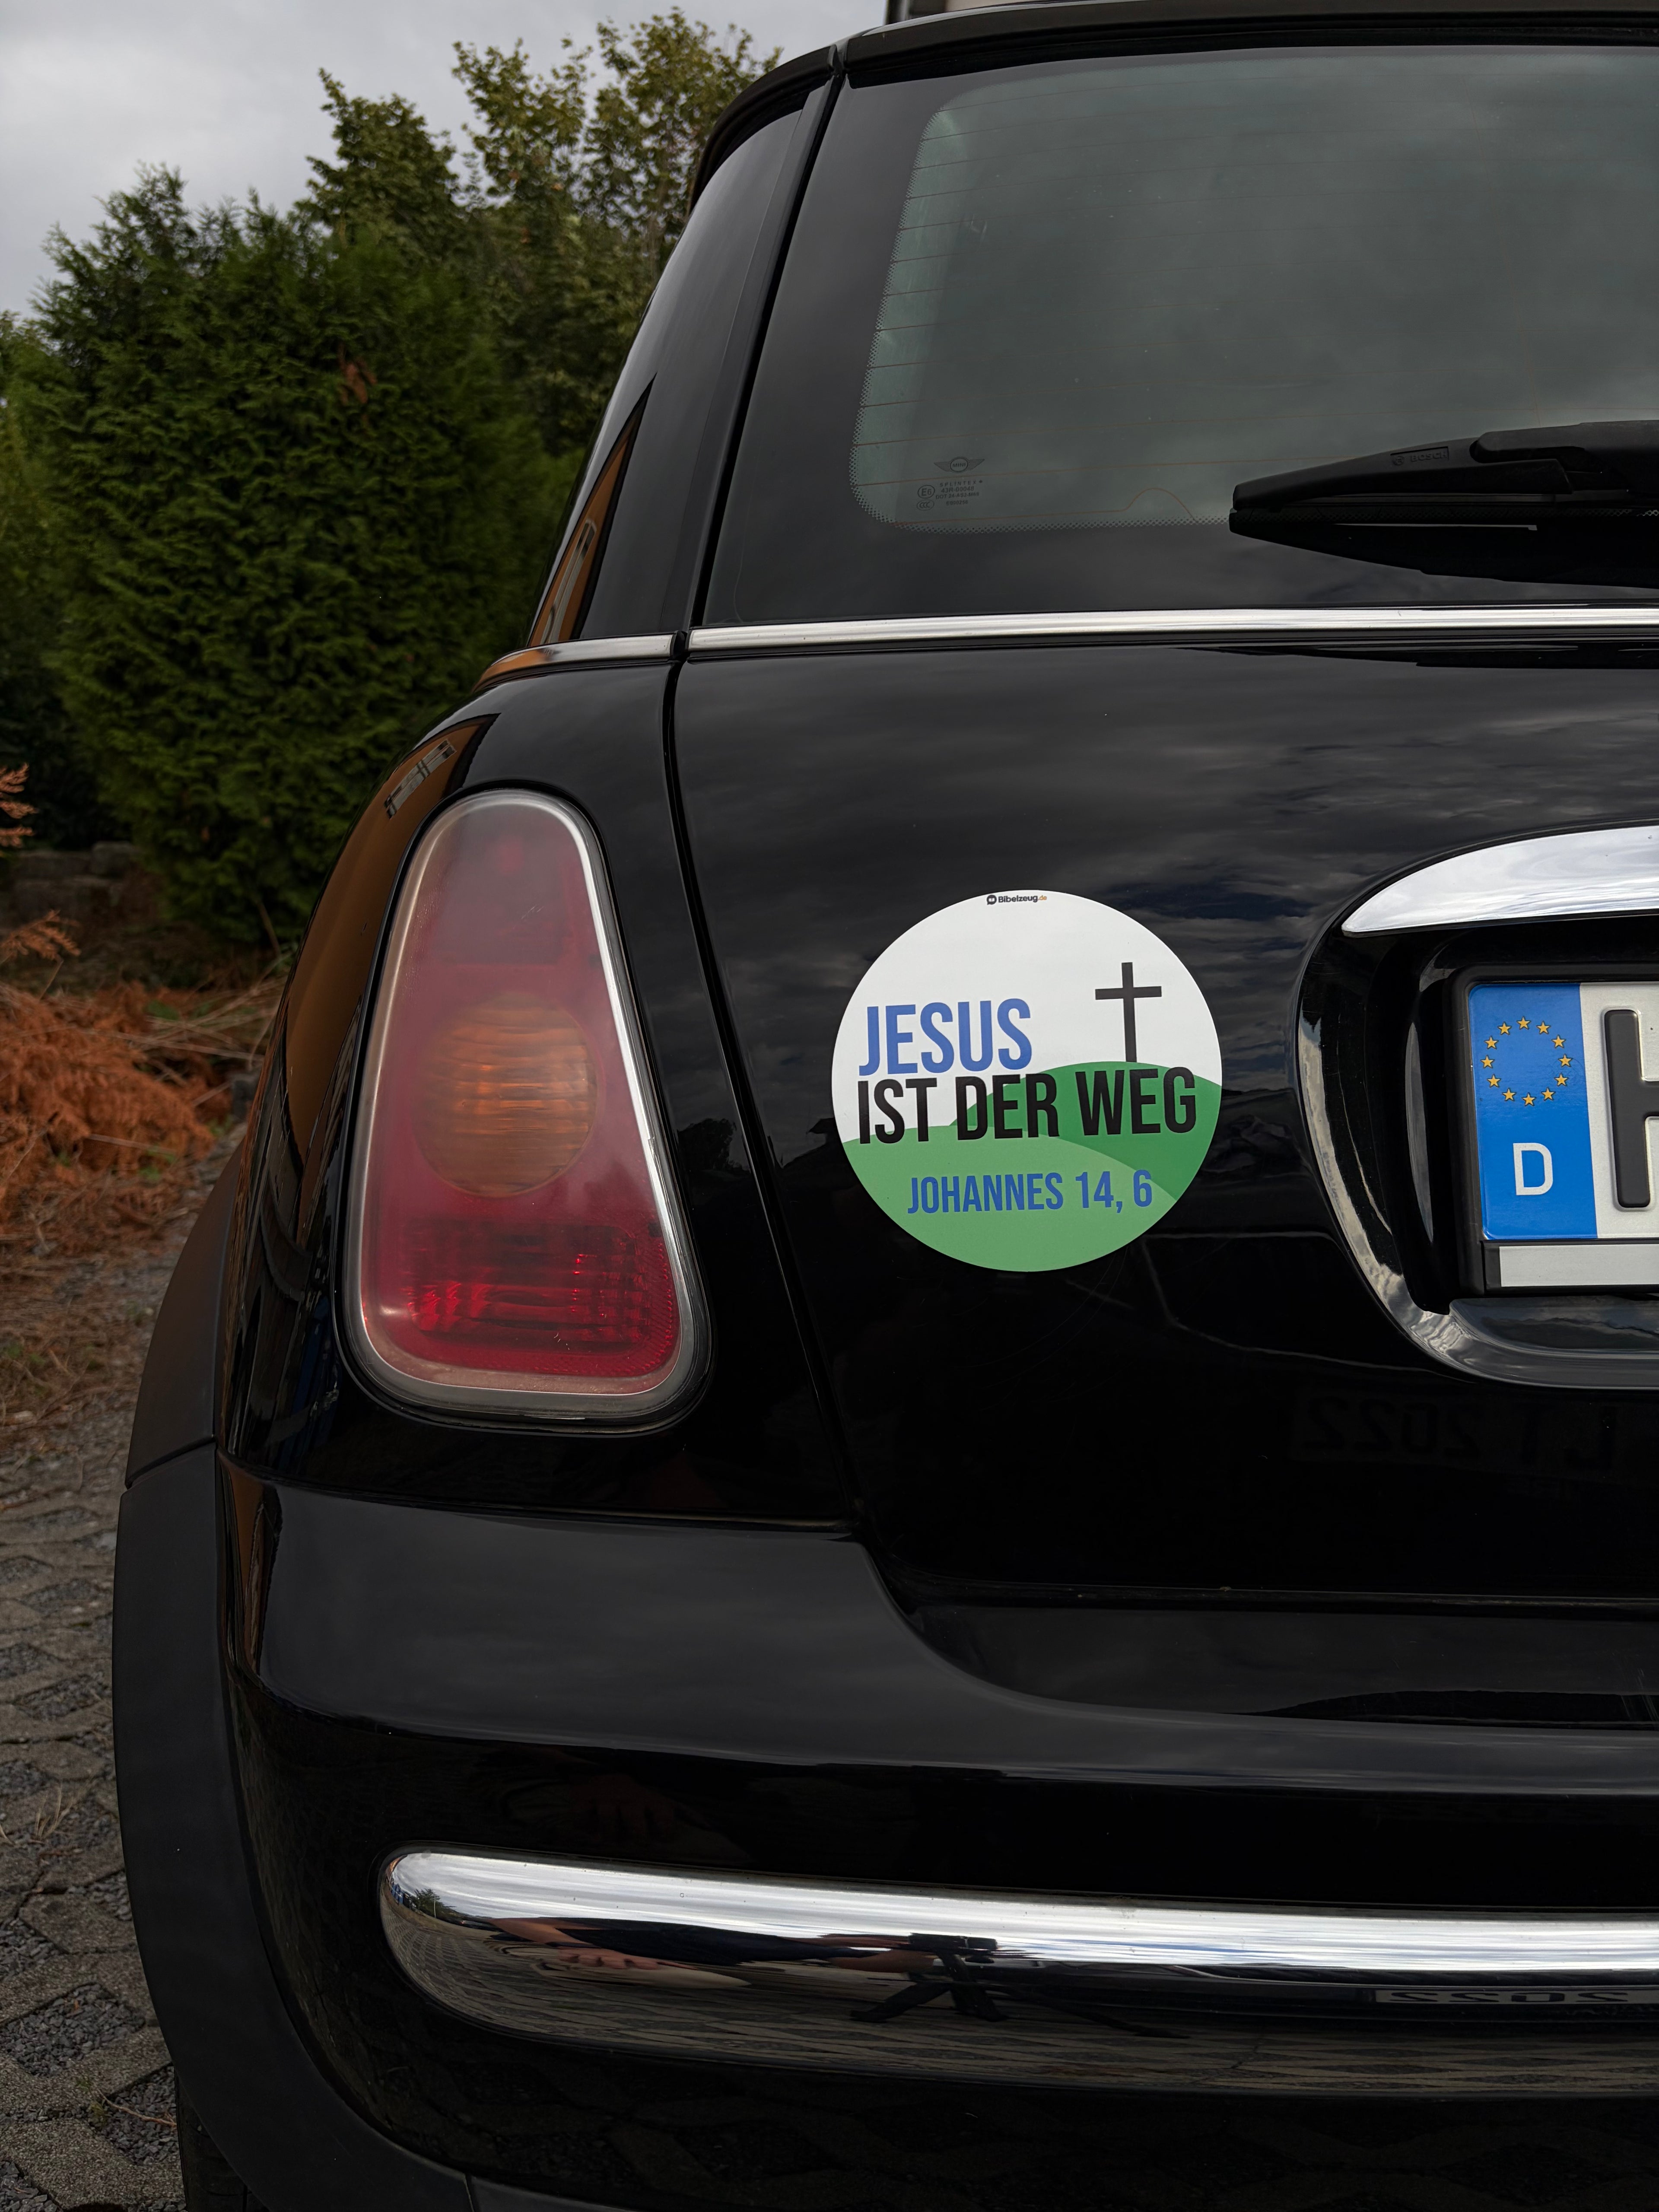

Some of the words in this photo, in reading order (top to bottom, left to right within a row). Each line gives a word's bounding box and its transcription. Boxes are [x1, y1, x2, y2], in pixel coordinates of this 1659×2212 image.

[1410, 451, 1448, 462] BOSCH
[921, 488, 932, 496] E6
[998, 895, 1047, 903] Bibelzeug.de
[859, 998, 1032, 1076] JESUS
[858, 1077, 938, 1144] IST
[955, 1073, 1060, 1141] DER
[1075, 1066, 1197, 1136] WEG
[908, 1172, 1064, 1214] JOHANNES
[1075, 1170, 1123, 1213] 14,
[1133, 1169, 1153, 1207] 6
[1513, 1142, 1554, 1196] D
